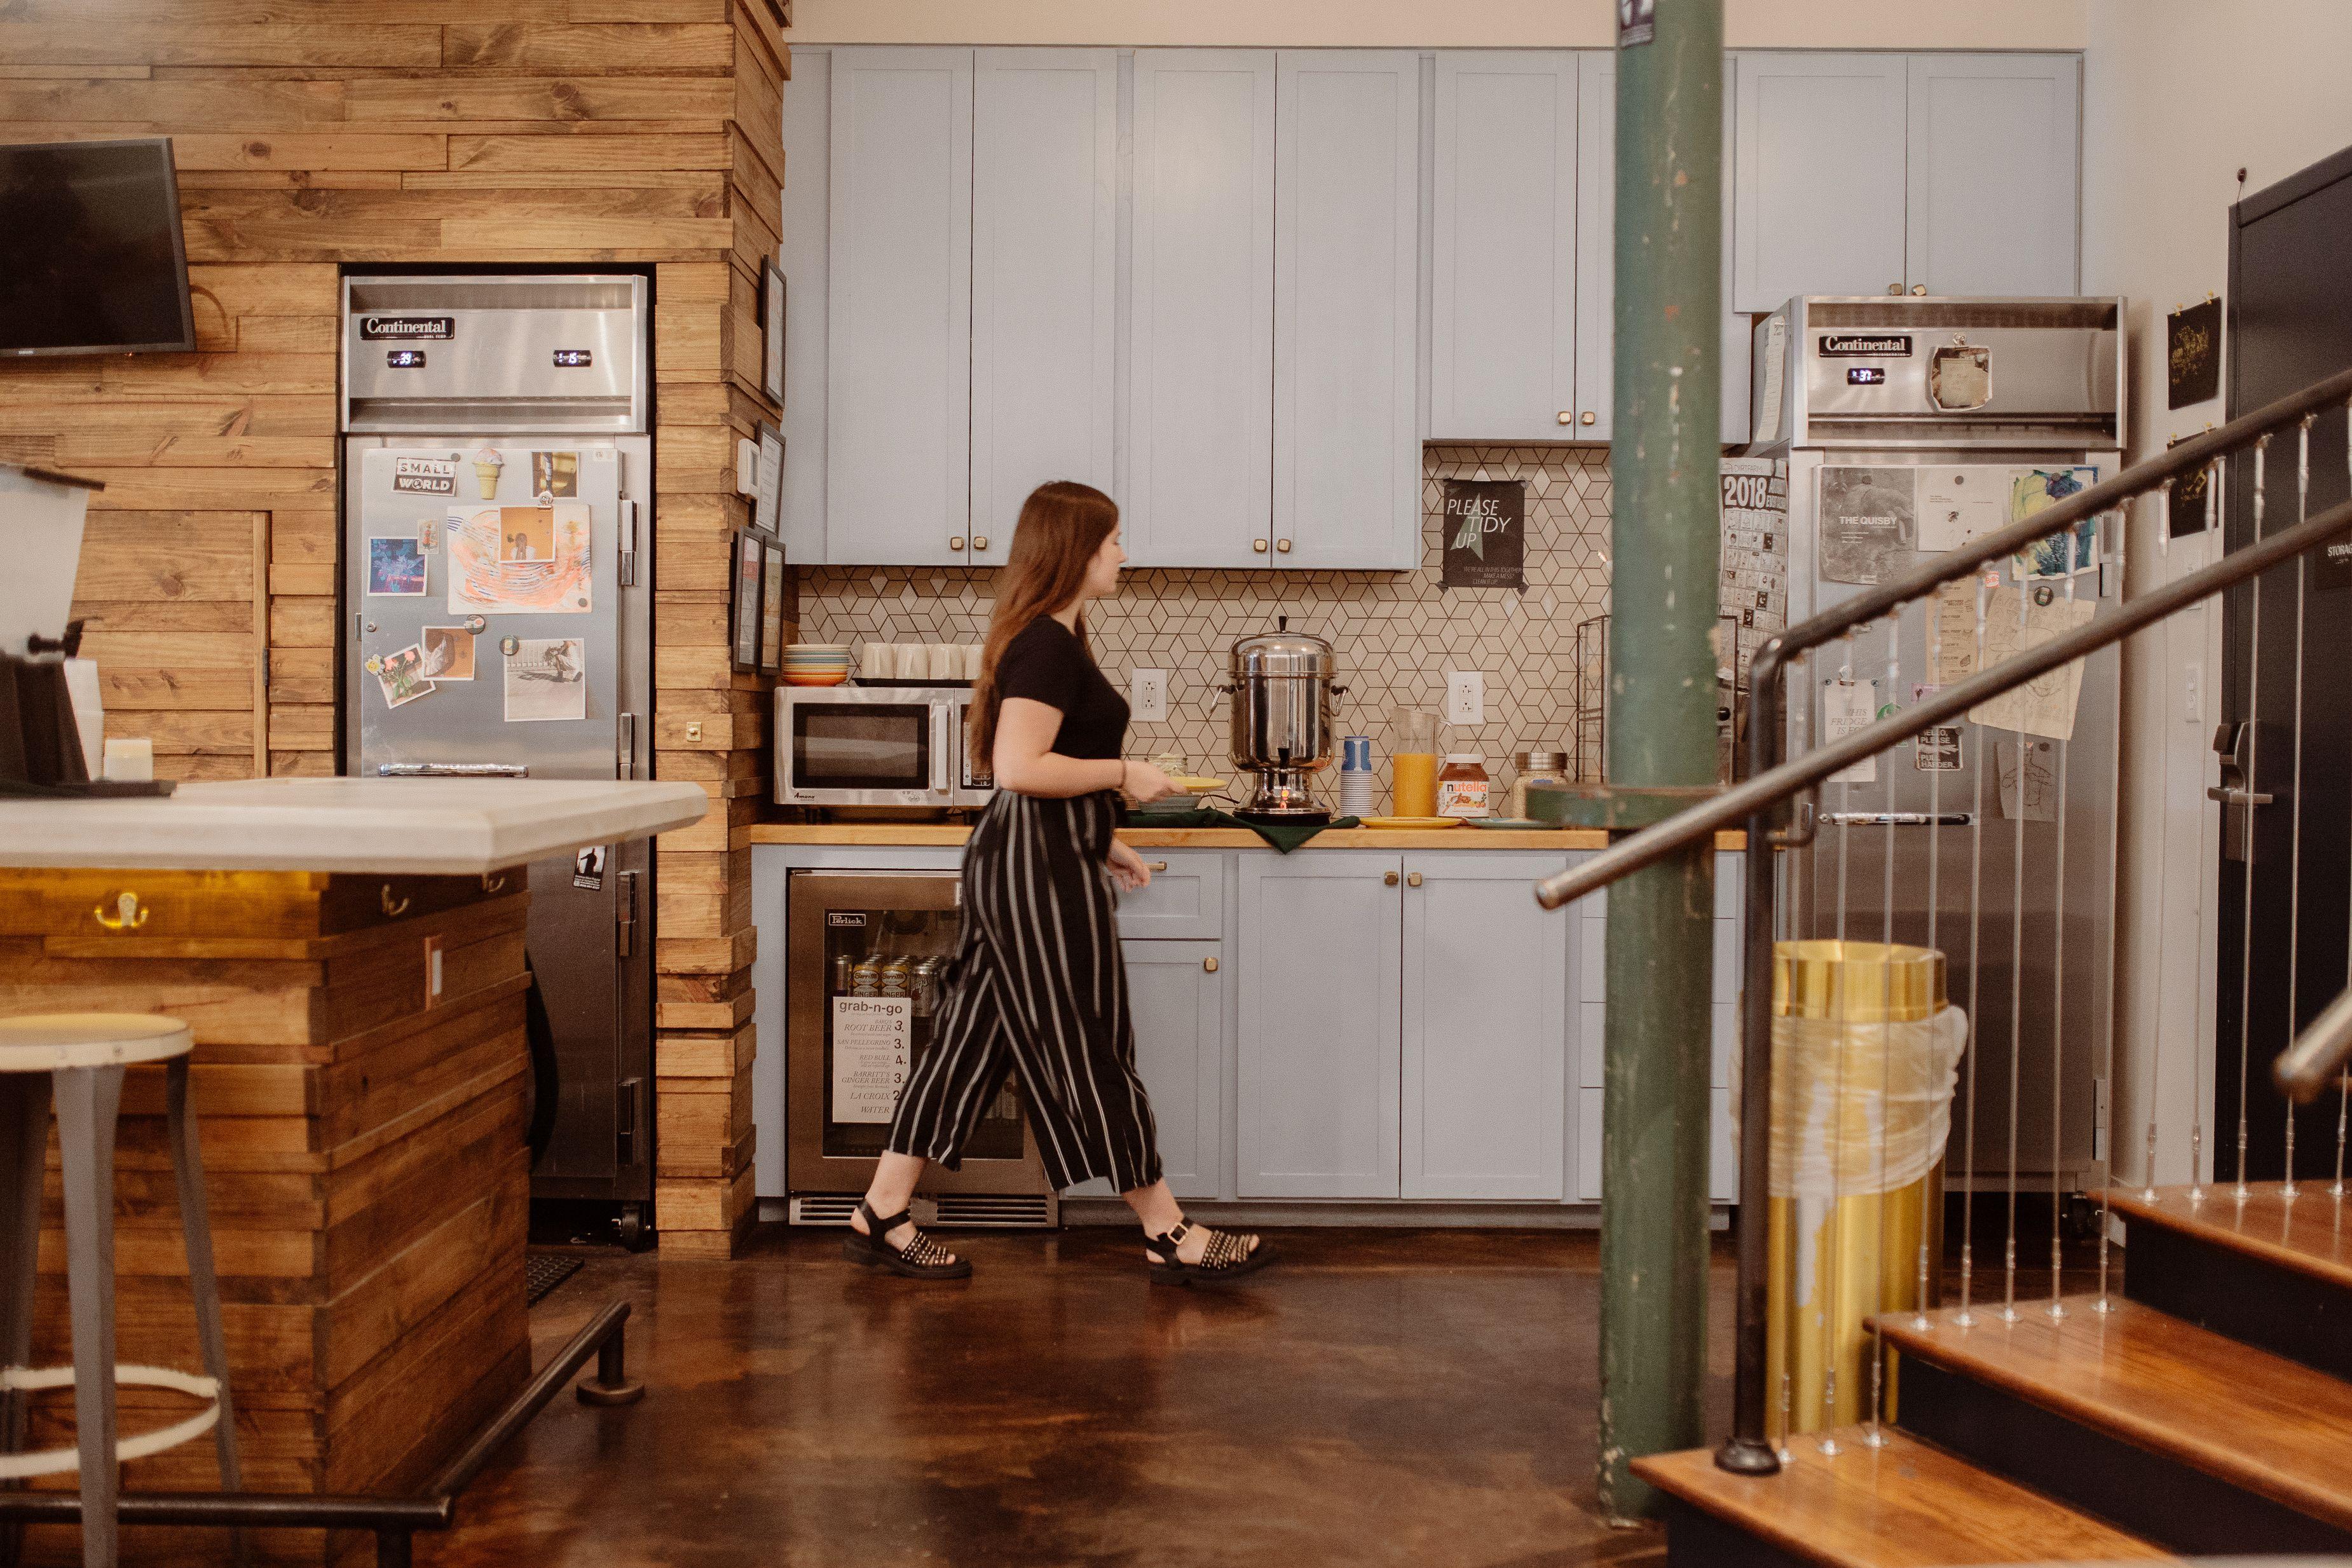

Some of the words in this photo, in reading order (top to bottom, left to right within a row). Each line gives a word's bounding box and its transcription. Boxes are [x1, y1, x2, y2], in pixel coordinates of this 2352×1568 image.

[367, 318, 446, 334] Continental
[1826, 336, 1906, 351] Continental
[400, 353, 412, 365] 39
[400, 463, 450, 474] SMALL
[399, 478, 450, 491] WORLD
[1724, 476, 1767, 508] 2018
[1447, 499, 1500, 515] PLEASE
[1467, 517, 1512, 533] TIDY
[1861, 517, 1897, 525] QUISBY
[1456, 533, 1477, 548] UP
[2328, 543, 2352, 557] STORAG
[1447, 781, 1487, 793] nutella
[831, 915, 863, 924] Perlick
[840, 1001, 903, 1016] grab-n-go
[894, 1020, 904, 1032] 3.
[894, 1038, 905, 1049] 3.
[896, 1055, 906, 1065] 4.
